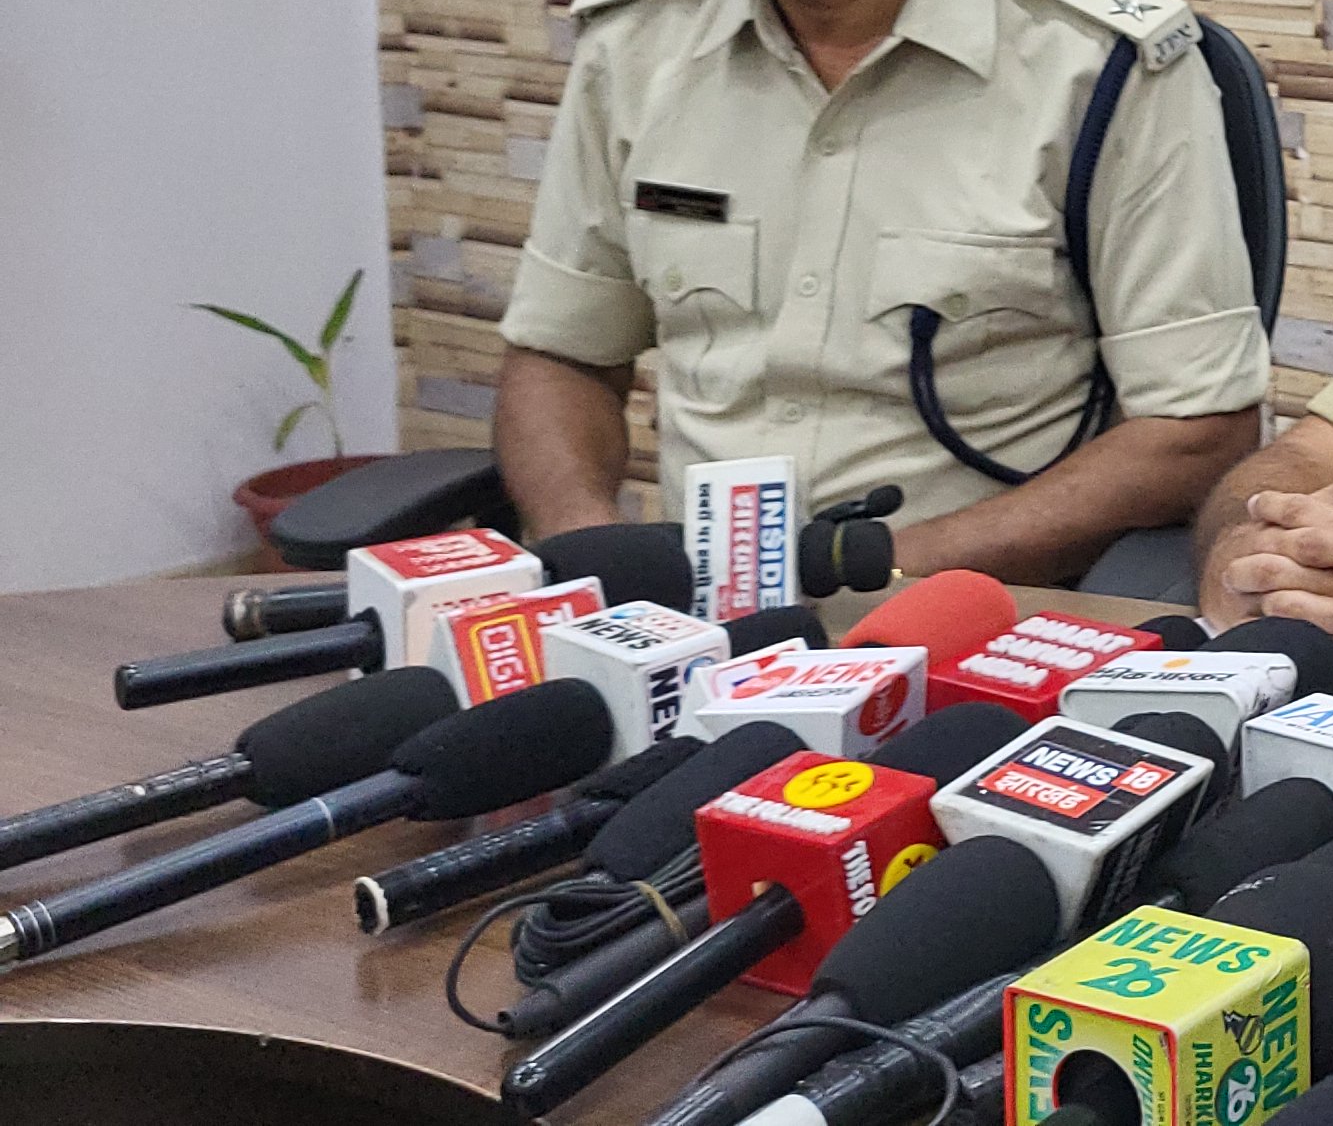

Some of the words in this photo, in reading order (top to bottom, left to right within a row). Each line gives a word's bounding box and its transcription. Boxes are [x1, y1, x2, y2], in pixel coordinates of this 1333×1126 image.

[760, 488, 785, 609] INSIDE
[573, 618, 663, 650] NEWS
[788, 658, 897, 686] NEWS
[1022, 746, 1119, 786] NEWS
[1120, 766, 1163, 789] 18
[994, 770, 1090, 809] झारखंड
[1096, 917, 1271, 974] NEWS
[1076, 957, 1180, 998] 26
[1262, 975, 1301, 1112] NEW
